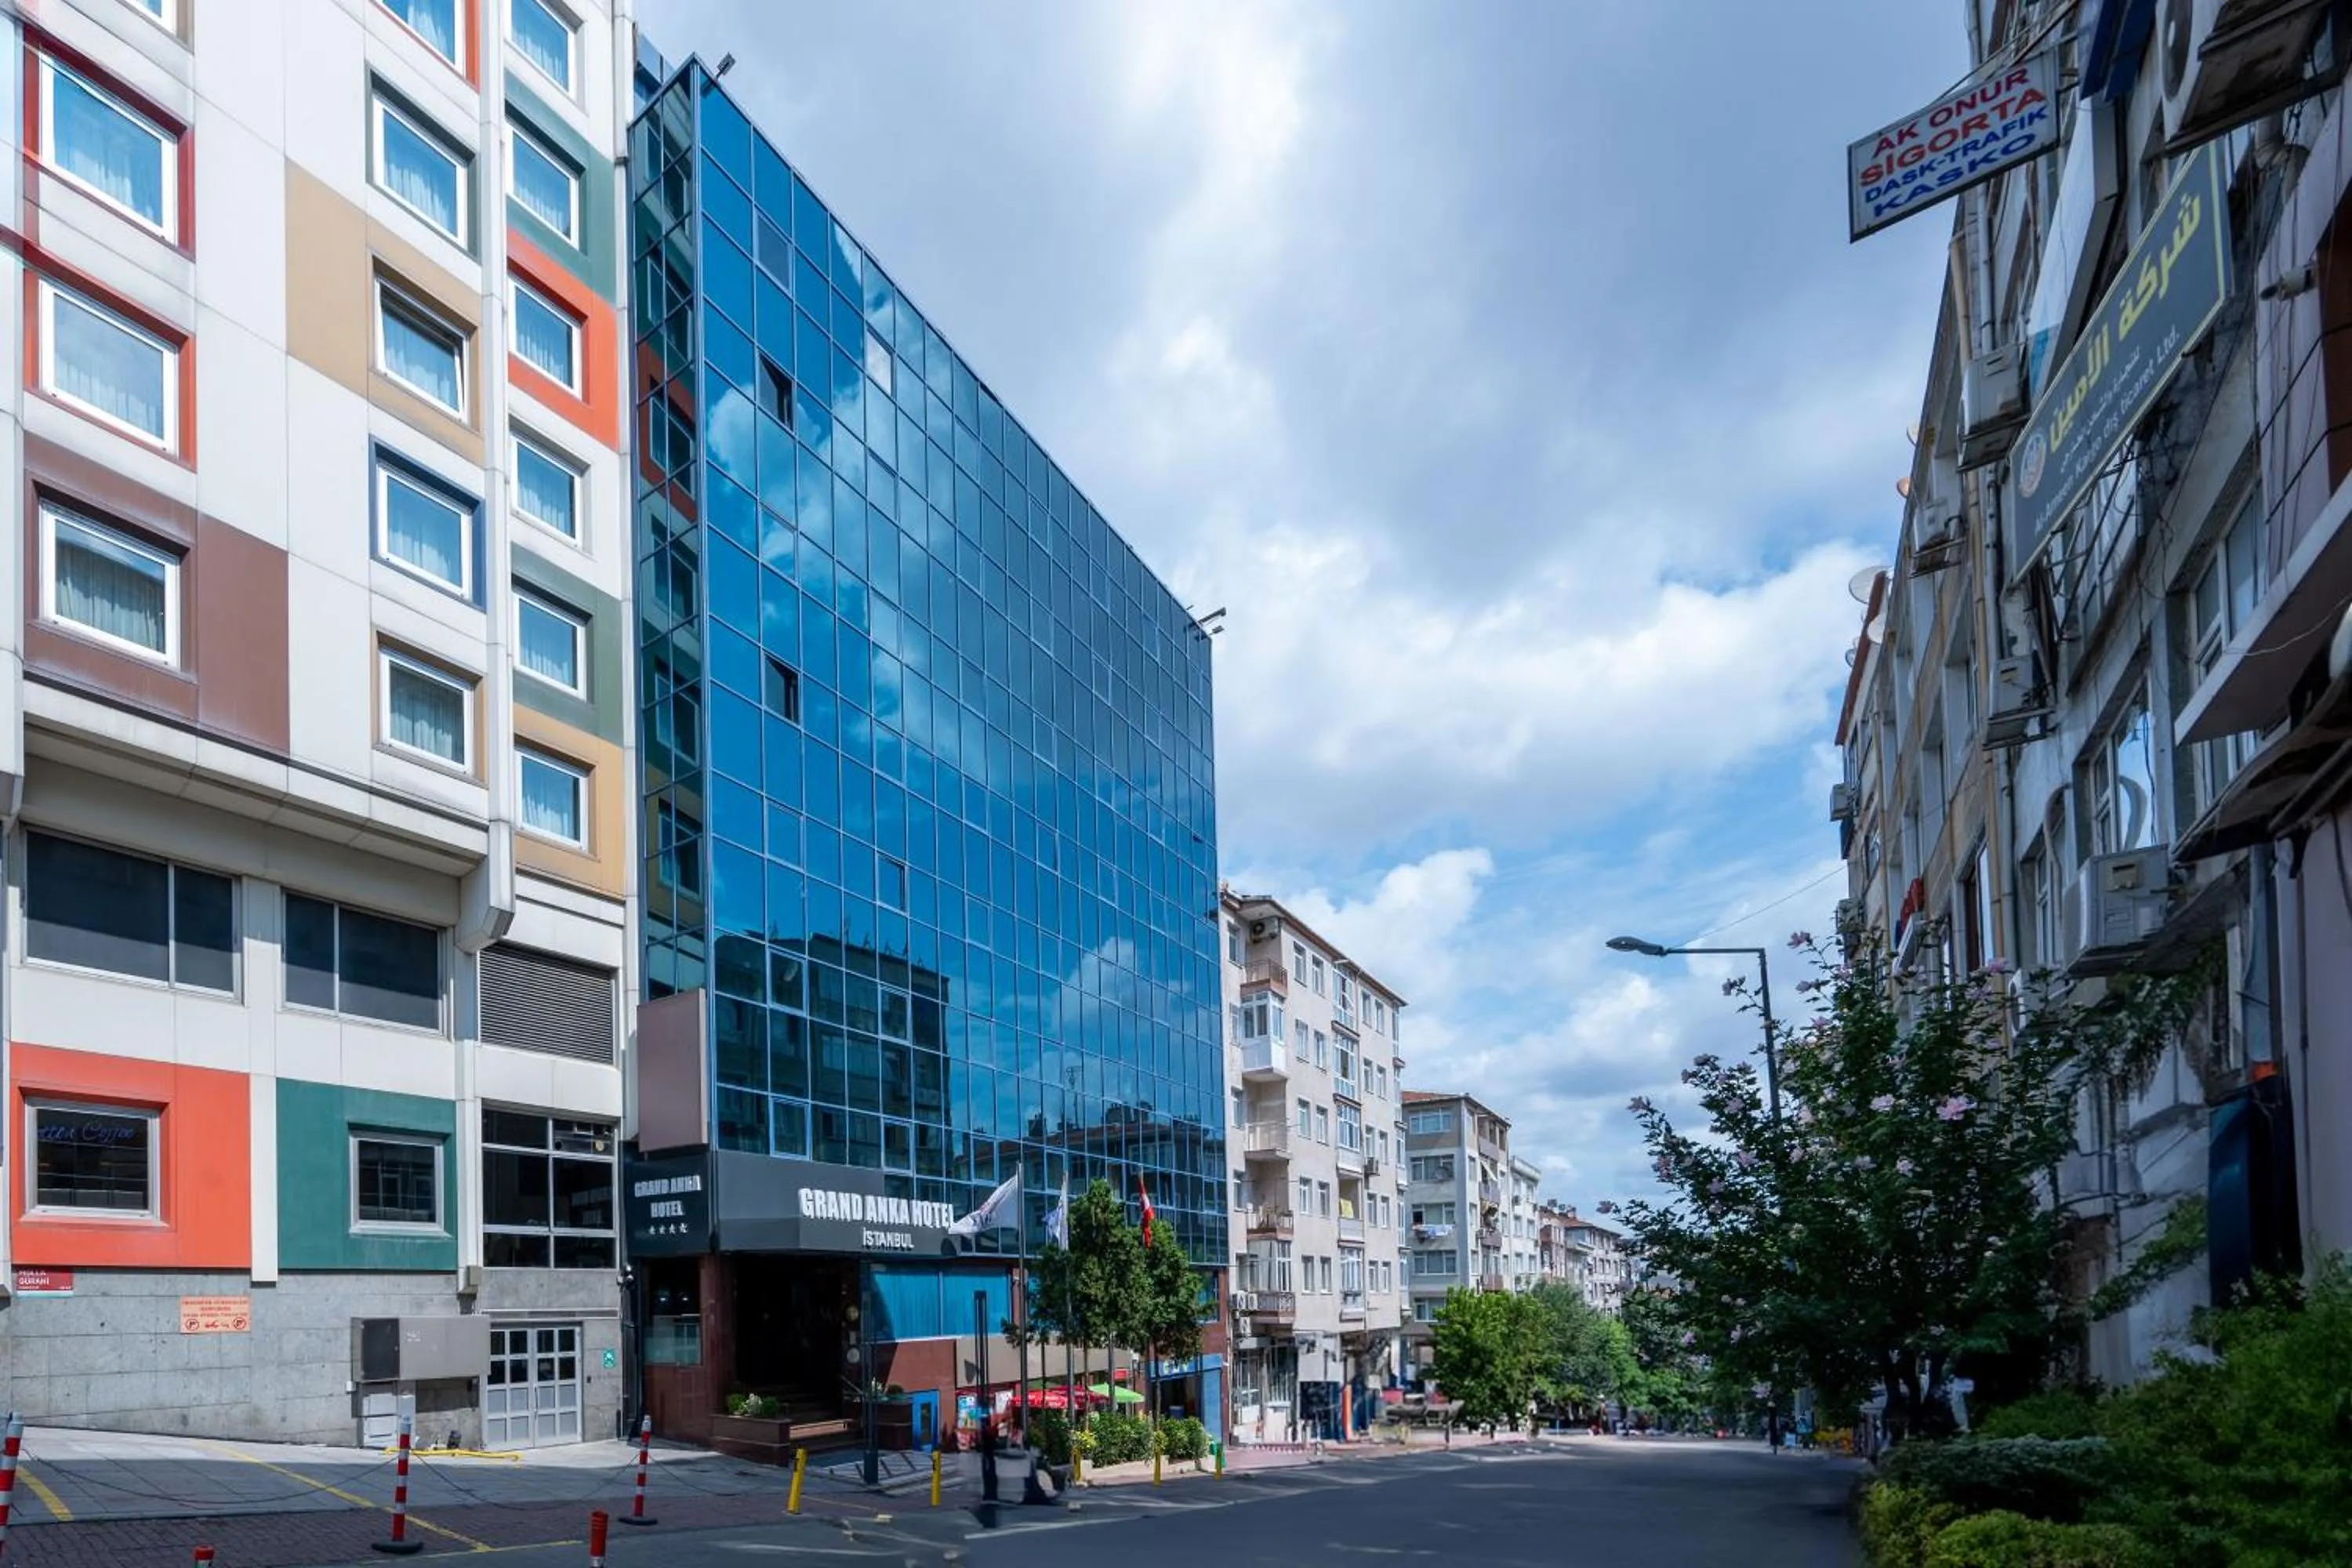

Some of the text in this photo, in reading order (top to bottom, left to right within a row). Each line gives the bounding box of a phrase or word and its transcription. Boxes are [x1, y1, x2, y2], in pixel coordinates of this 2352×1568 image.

[1865, 105, 2048, 202] DASK-TRAFIK
[1871, 68, 2030, 159] AK ONUR
[1874, 133, 2036, 216] KASKO
[2118, 193, 2201, 341] شركة
[651, 1200, 684, 1218] HOTEL
[798, 1188, 862, 1221] GRAND
[864, 1195, 909, 1225] ANKA
[910, 1200, 955, 1229] HOTEL
